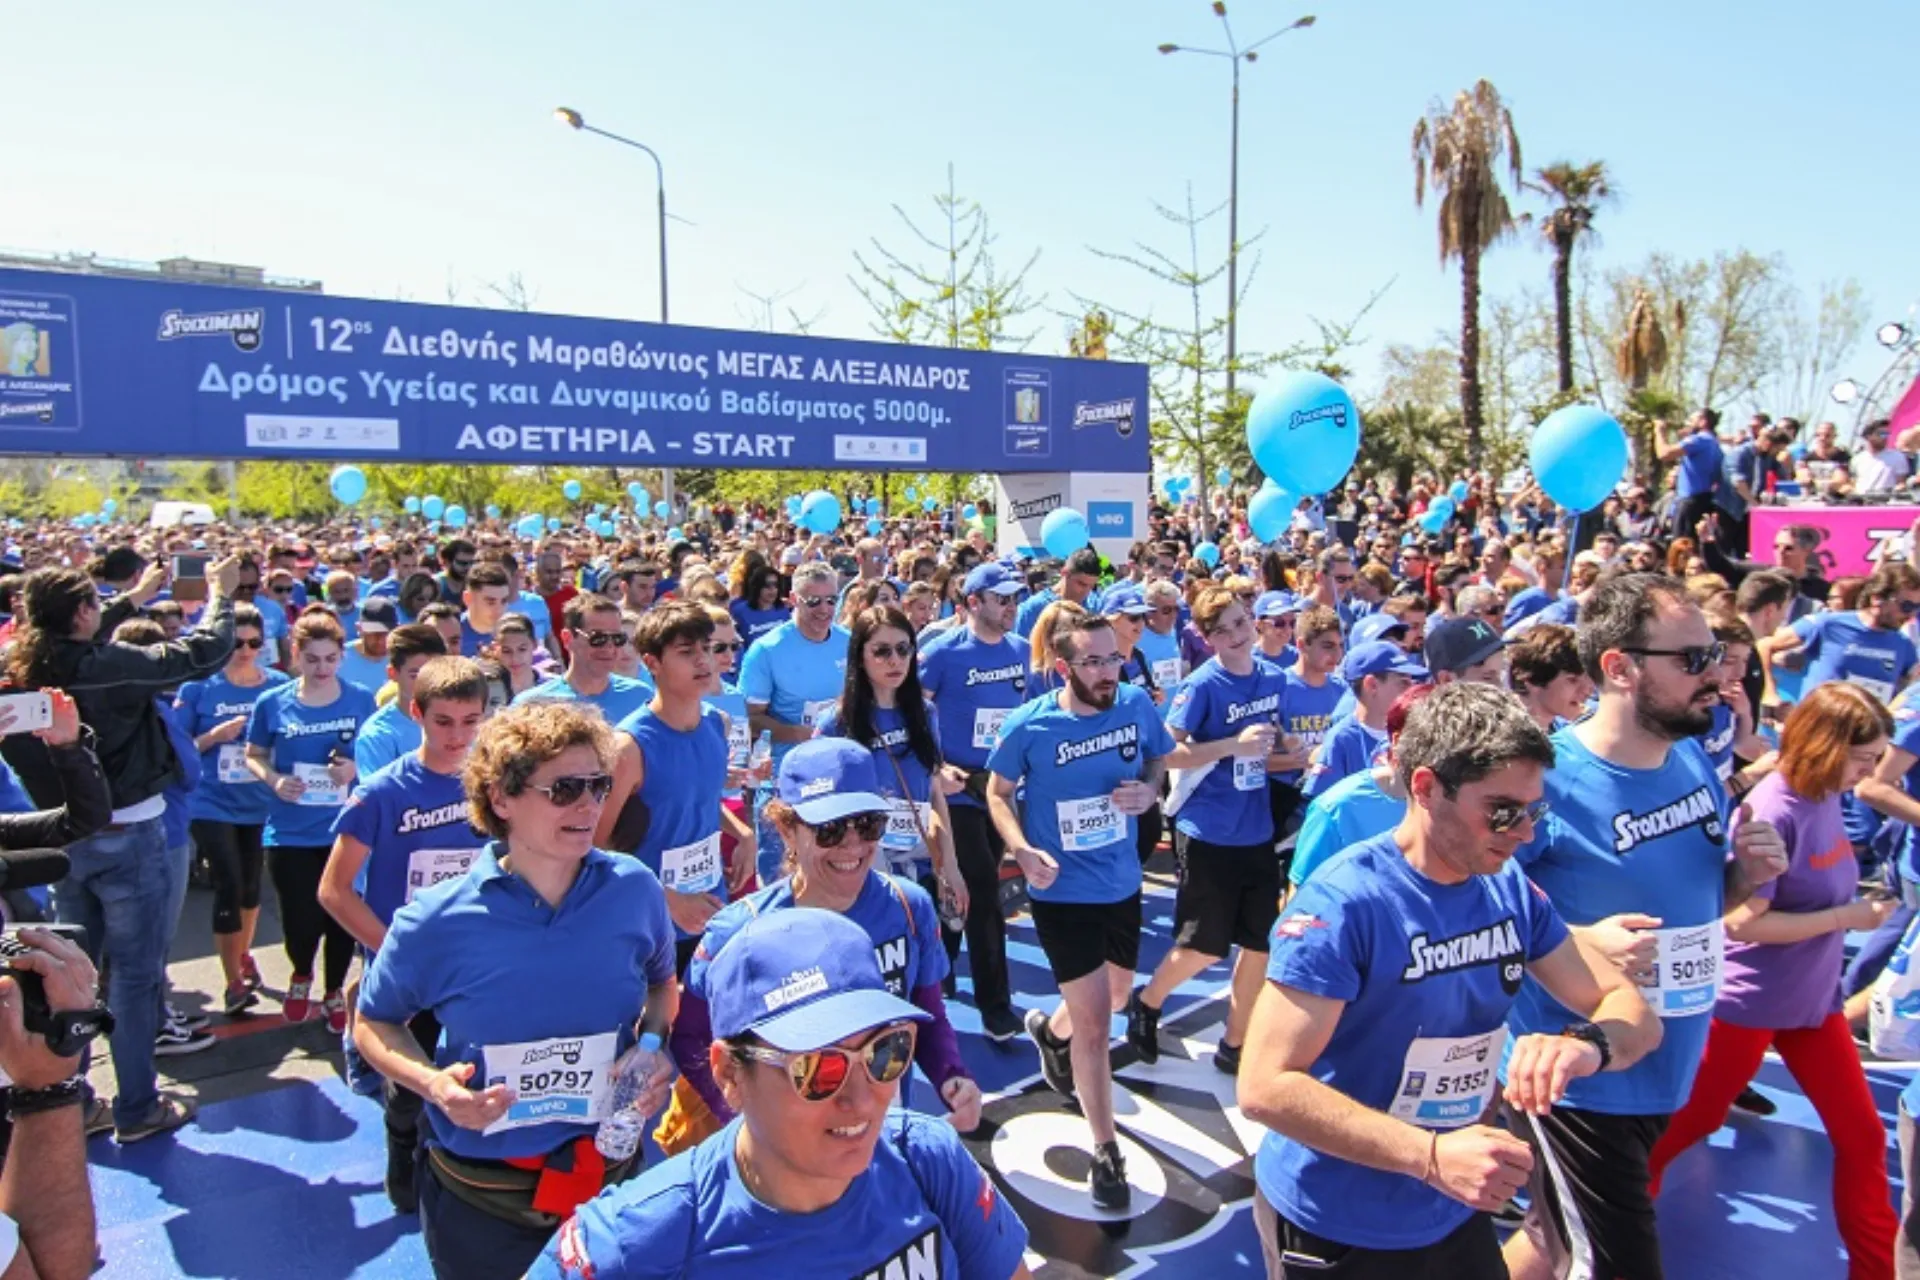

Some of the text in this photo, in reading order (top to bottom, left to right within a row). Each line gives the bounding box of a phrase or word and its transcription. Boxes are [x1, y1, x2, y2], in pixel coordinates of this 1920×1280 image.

[162, 312, 260, 337] STOIXIMAN
[383, 326, 518, 367] Διεθνής
[528, 335, 708, 380] Μαραθώνιος
[718, 350, 805, 380] ΜΕΓΑΣ
[811, 357, 970, 391] ΑΛΕΞΑΝΔΡΟΣ
[198, 362, 348, 404] Δρόμος
[359, 371, 478, 407] Υγείας
[489, 383, 540, 405] και
[551, 380, 711, 416] Δυναμικού
[721, 389, 866, 425] Βαδίσματος
[456, 424, 656, 454] ΑΦΕΤΗΡΙΑ
[693, 431, 795, 458] START
[1057, 725, 1137, 765] STOIXIMAN
[1615, 787, 1716, 852] STOIXIMAN
[520, 1070, 593, 1092] 50797
[529, 1100, 567, 1114] WIND
